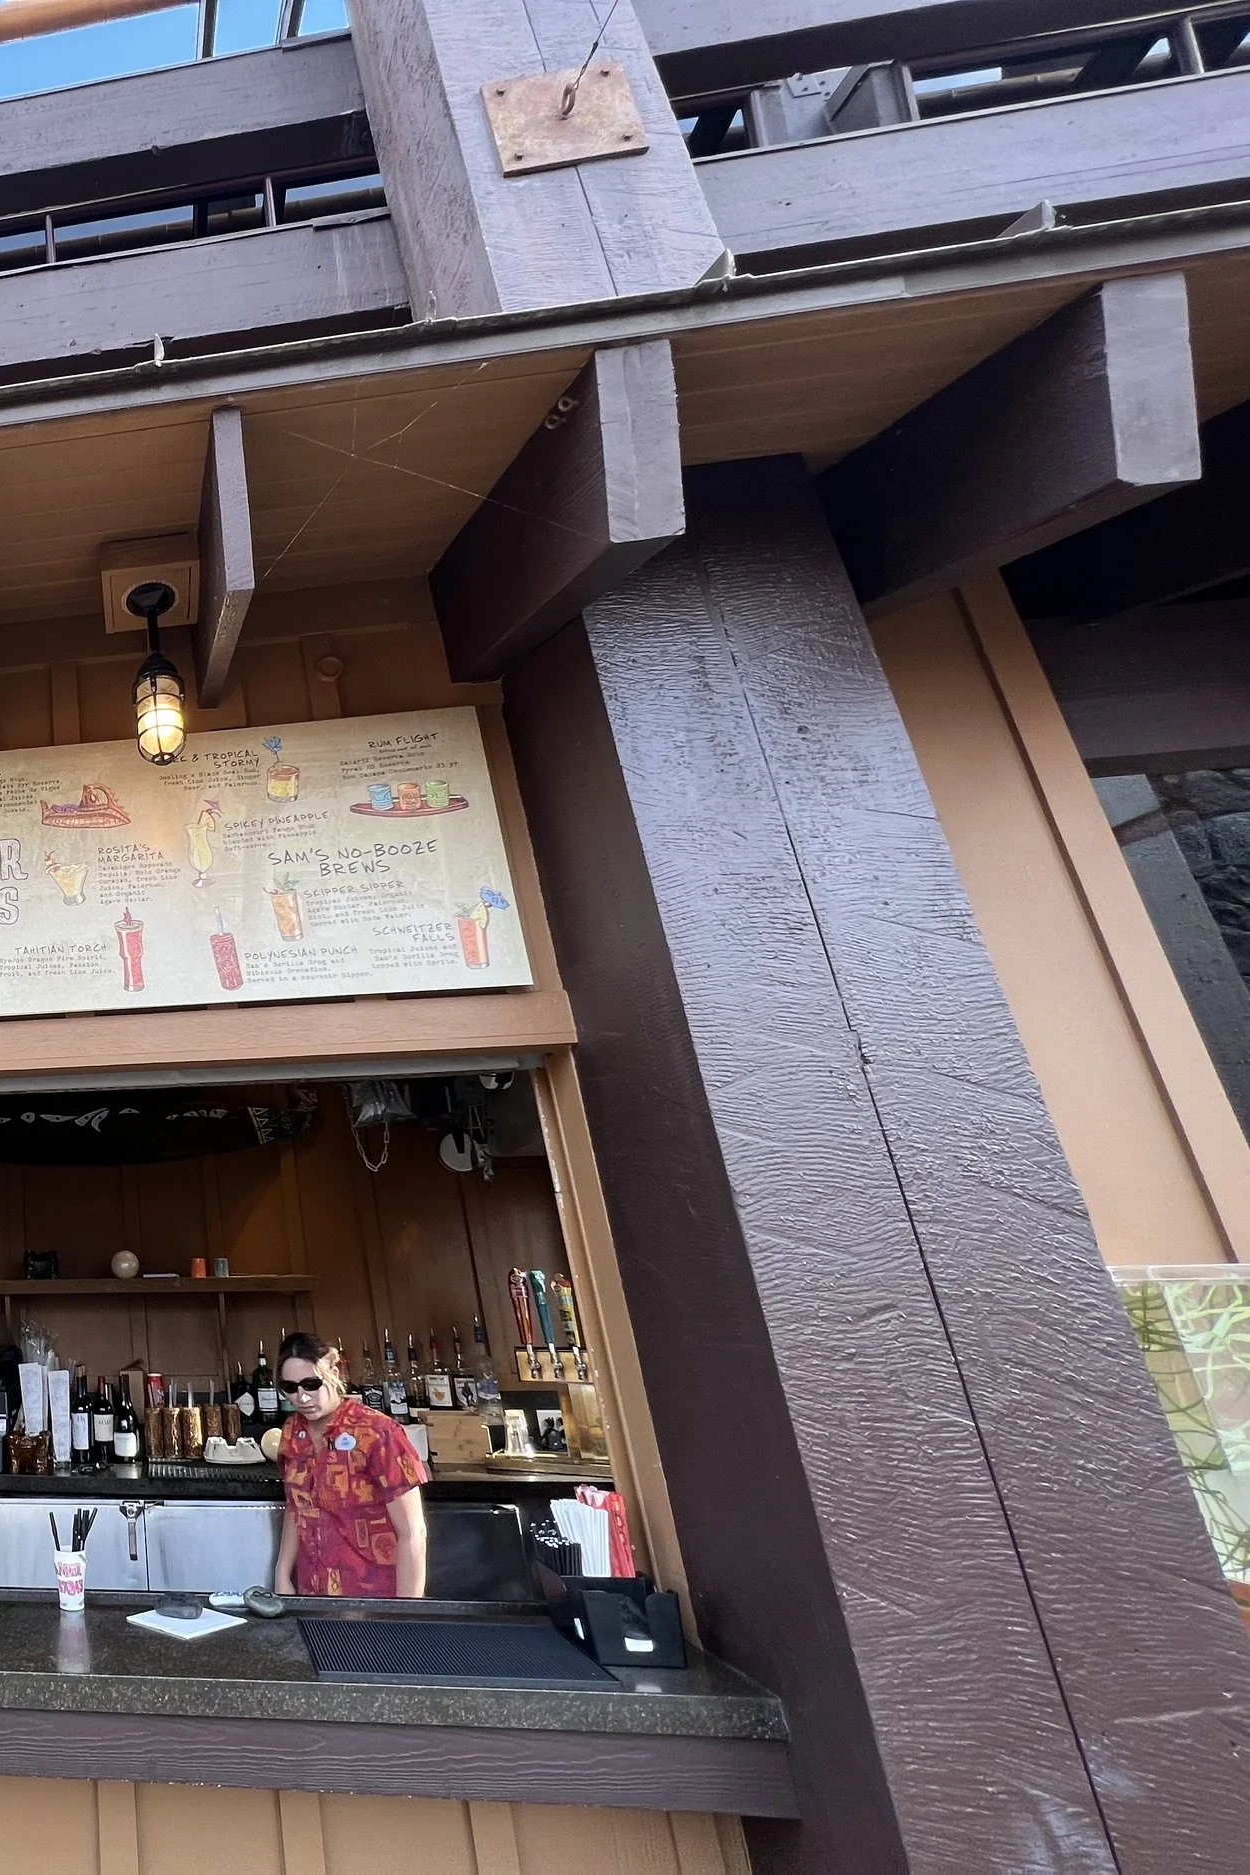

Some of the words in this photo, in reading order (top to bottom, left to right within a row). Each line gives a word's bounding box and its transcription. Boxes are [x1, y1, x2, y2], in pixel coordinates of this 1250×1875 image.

[396, 733, 438, 745] FLIGHT
[192, 754, 198, 762] &
[204, 750, 258, 760] TROPICAL
[214, 757, 259, 768] STORMY
[225, 819, 263, 831] SPIKEY
[269, 811, 328, 824] PINEAPPLE
[98, 844, 150, 855] ROSITA'S
[268, 848, 329, 866] SAM'S
[338, 840, 438, 860] NO-BOOZE
[98, 852, 164, 864] MARGARITA
[319, 860, 390, 876] BREWS
[304, 886, 354, 898] SKIPPER
[361, 880, 404, 892] SIPPER
[372, 922, 453, 936] SCHNEITZER
[413, 933, 455, 942] FALLS
[15, 946, 64, 955] TAHITIAN
[70, 944, 106, 952] TORCH
[245, 949, 316, 961] POLYNESIAN
[321, 946, 357, 955] PUNCH
